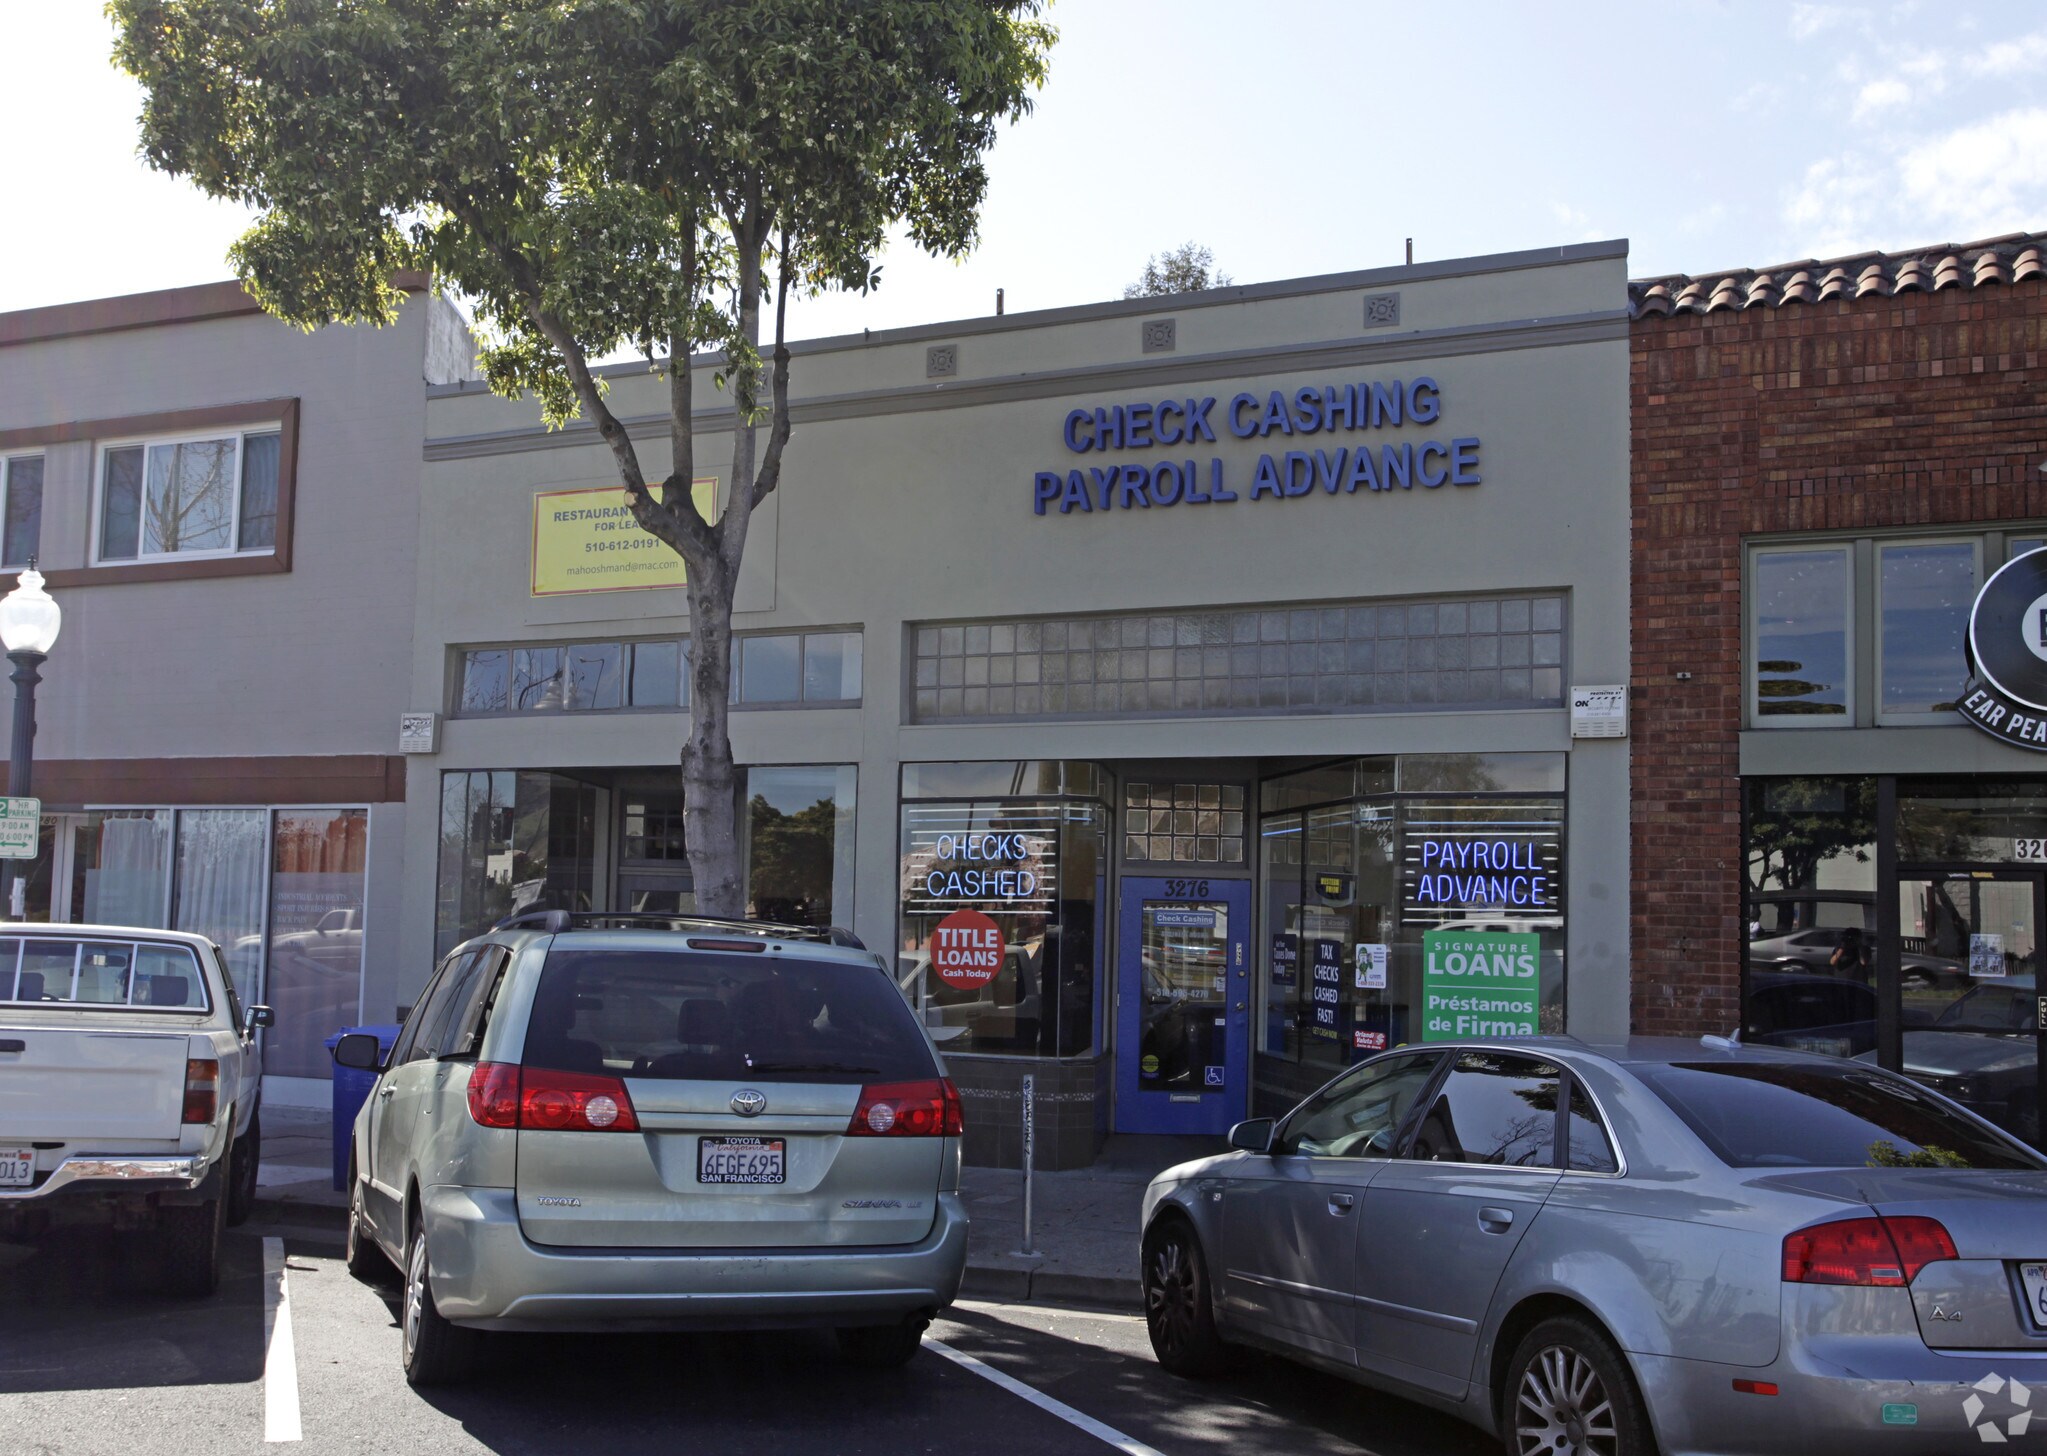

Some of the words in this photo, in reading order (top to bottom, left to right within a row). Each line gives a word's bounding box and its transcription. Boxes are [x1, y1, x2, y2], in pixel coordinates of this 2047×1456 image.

[1063, 397, 1217, 453] CHECK
[1228, 376, 1441, 439] CASHING
[1034, 457, 1239, 516] PAYROLL
[1250, 437, 1481, 500] ADVANCE
[553, 506, 629, 523] RESTAURAN
[594, 522, 616, 532] FOR
[618, 519, 640, 530] LEA
[585, 538, 660, 553] 510-612-0191
[566, 559, 679, 577] mahooshmand@mac.com
[1964, 689, 2007, 727] EAR
[2005, 713, 2047, 743] PEA
[936, 834, 1028, 861] CHECKS
[1422, 840, 1544, 871] PAYROLL
[926, 870, 1037, 897] CASHED
[1164, 879, 1210, 898] 3276
[1416, 873, 1548, 905] ADVANCE
[1156, 914, 1181, 922] Check
[1182, 915, 1214, 925] Cashing
[937, 927, 998, 948] TITLE
[1320, 944, 1334, 961] TAX
[1434, 942, 1529, 954] SIGNATURE
[937, 950, 998, 966] LOANS
[1427, 952, 1536, 979] LOANS
[942, 968, 964, 978] Cash
[965, 969, 992, 980] Today
[1313, 963, 1339, 982] CHECKS
[1313, 986, 1338, 1004] CASHED
[1428, 995, 1534, 1014] Préstamos
[1317, 1007, 1334, 1024] FAST!
[1428, 1016, 1452, 1032] de
[1455, 1014, 1534, 1036] Firma
[1329, 1030, 1338, 1040] NOW
[717, 1144, 765, 1154] California
[724, 1137, 761, 1145] TOYOTA
[0, 1161, 29, 1179] 013
[704, 1154, 780, 1174] 6FGF695
[701, 1174, 722, 1183] SAN
[724, 1174, 783, 1183] FRANCISCO
[537, 1196, 581, 1207] TOYOTA
[841, 1200, 902, 1209] SIENNA
[2026, 1268, 2040, 1278] APR
[1929, 1304, 1963, 1322] A4
